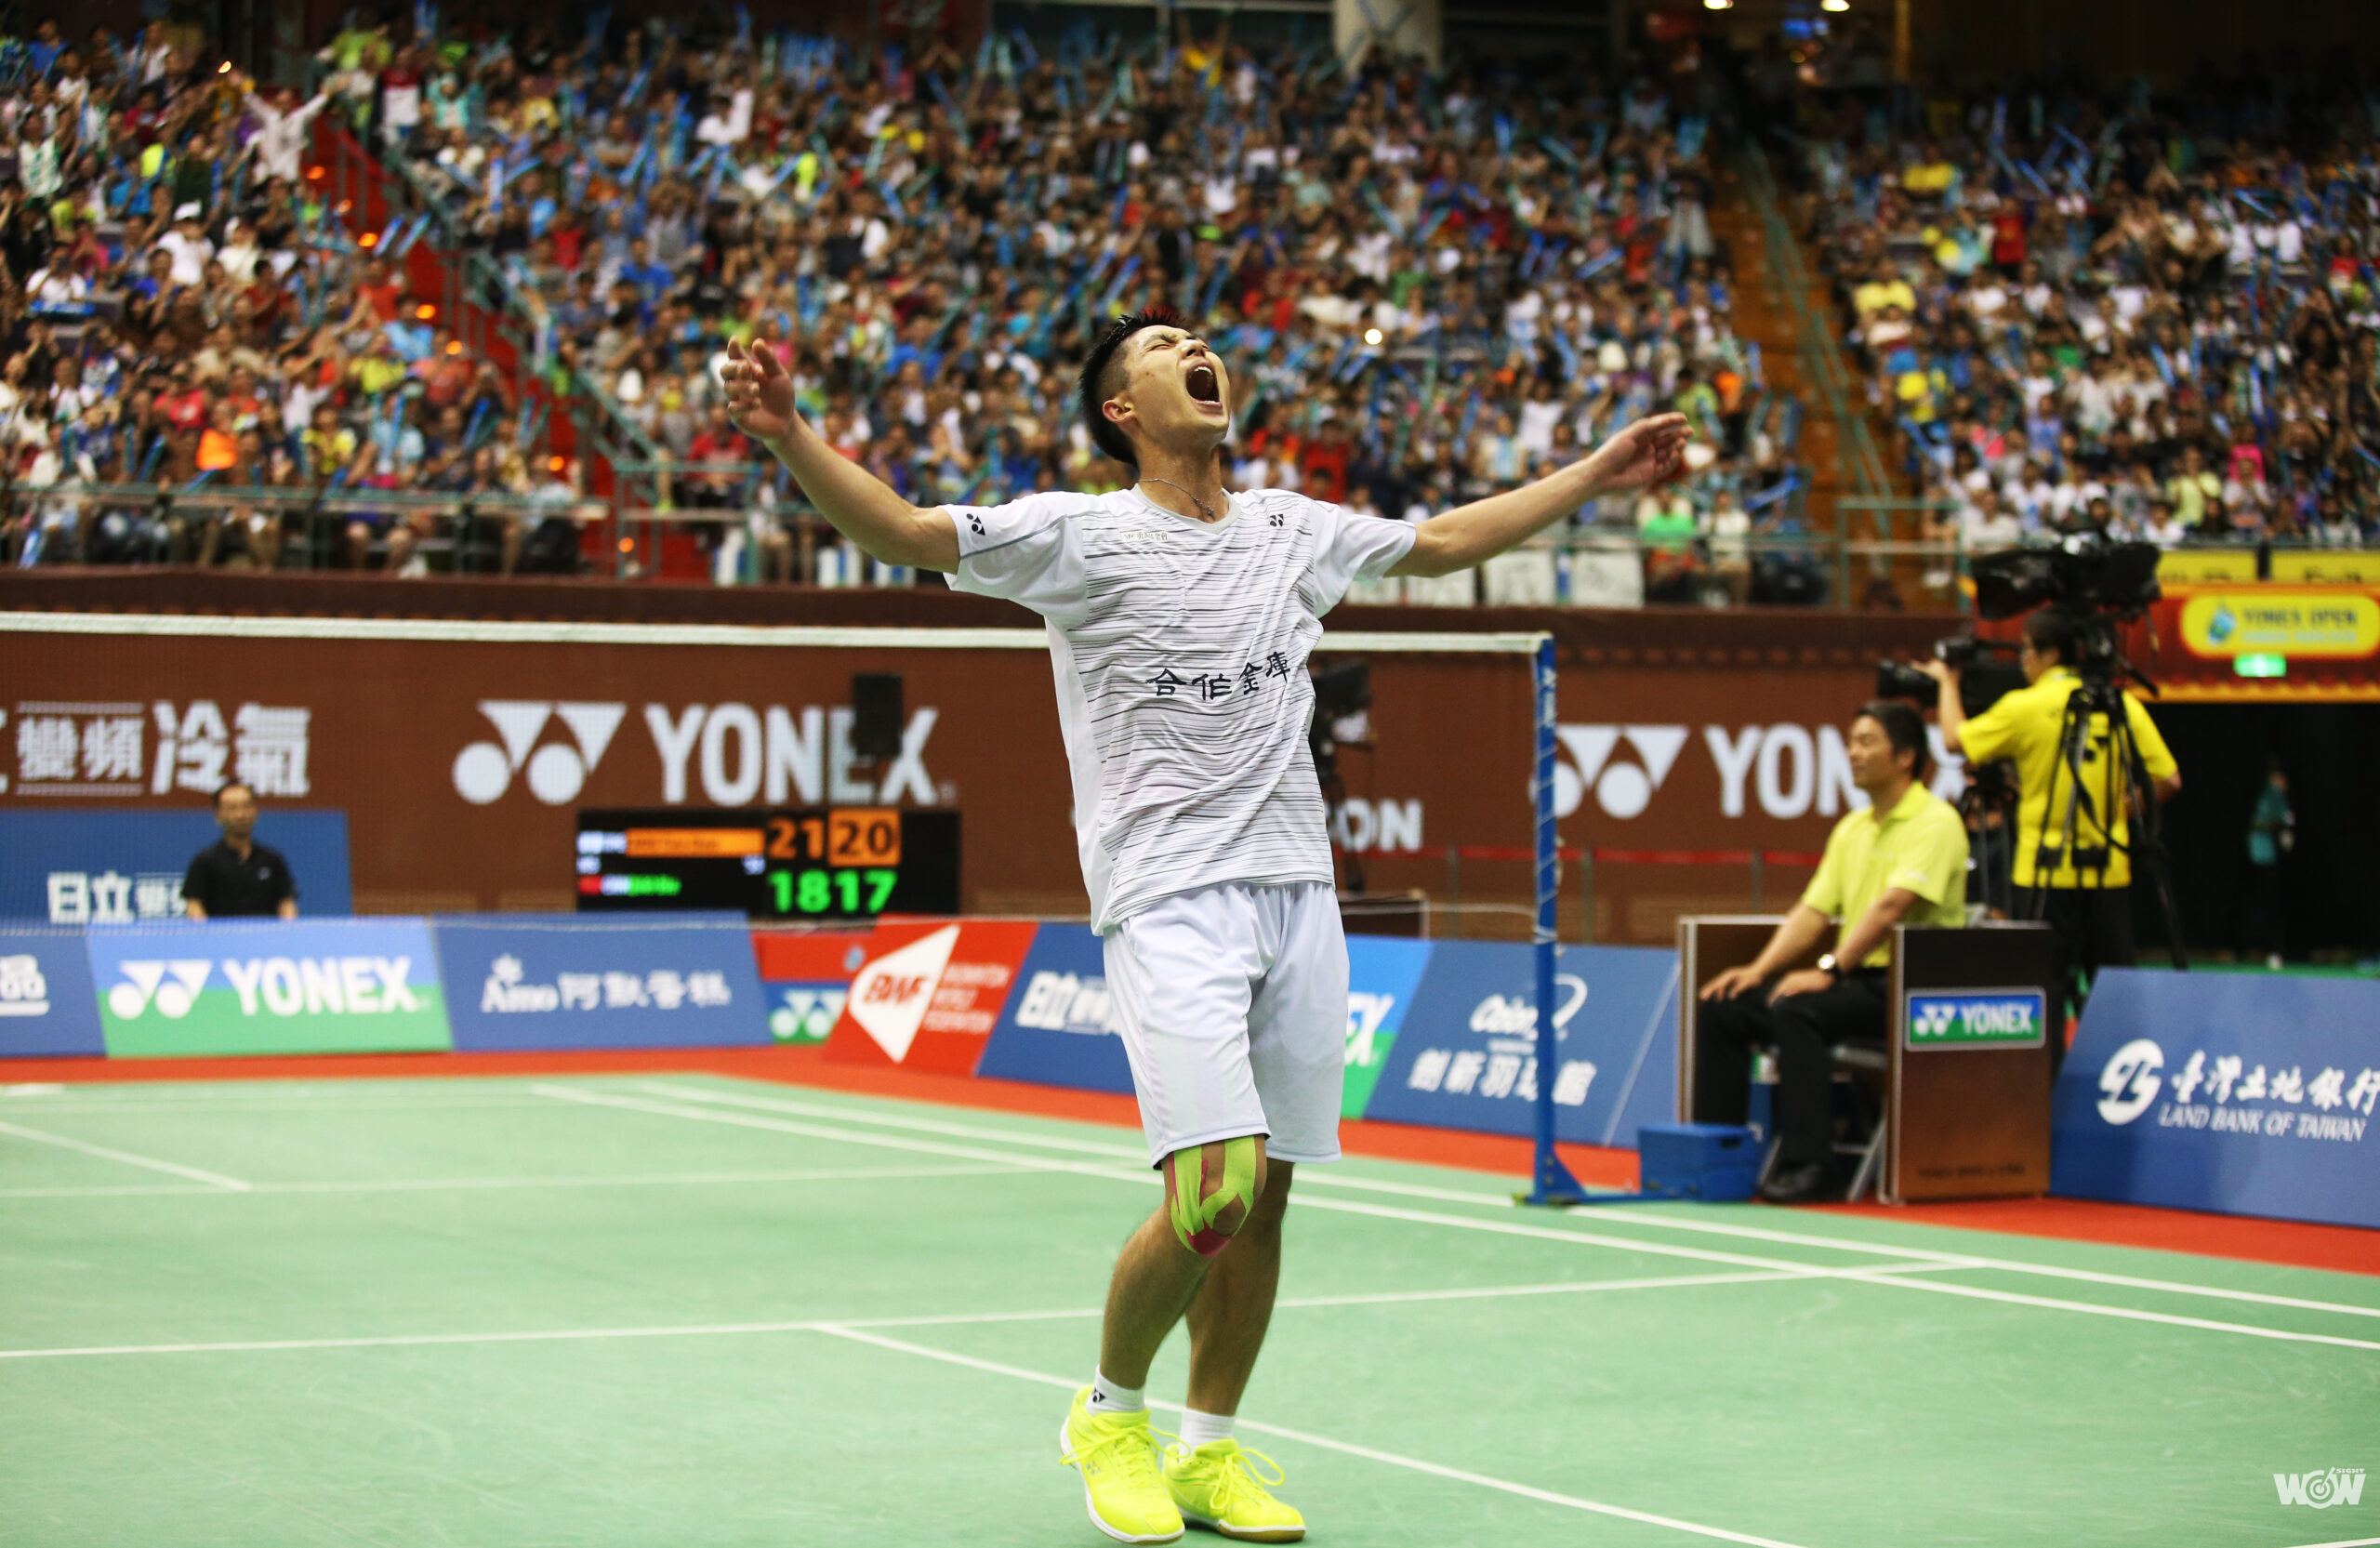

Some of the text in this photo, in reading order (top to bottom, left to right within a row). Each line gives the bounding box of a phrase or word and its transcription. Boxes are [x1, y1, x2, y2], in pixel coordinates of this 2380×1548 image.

[1145, 652, 1290, 701] 合作金庫
[0, 699, 311, 798] 變頻冷氣
[643, 702, 939, 807] YONEX
[767, 817, 894, 860] 21 20
[768, 868, 899, 913] 18 17
[221, 956, 419, 1017] YONEX
[1959, 1001, 2034, 1036] YONEX
[2158, 1102, 2367, 1143] LAND BANK OF TAIWAN
